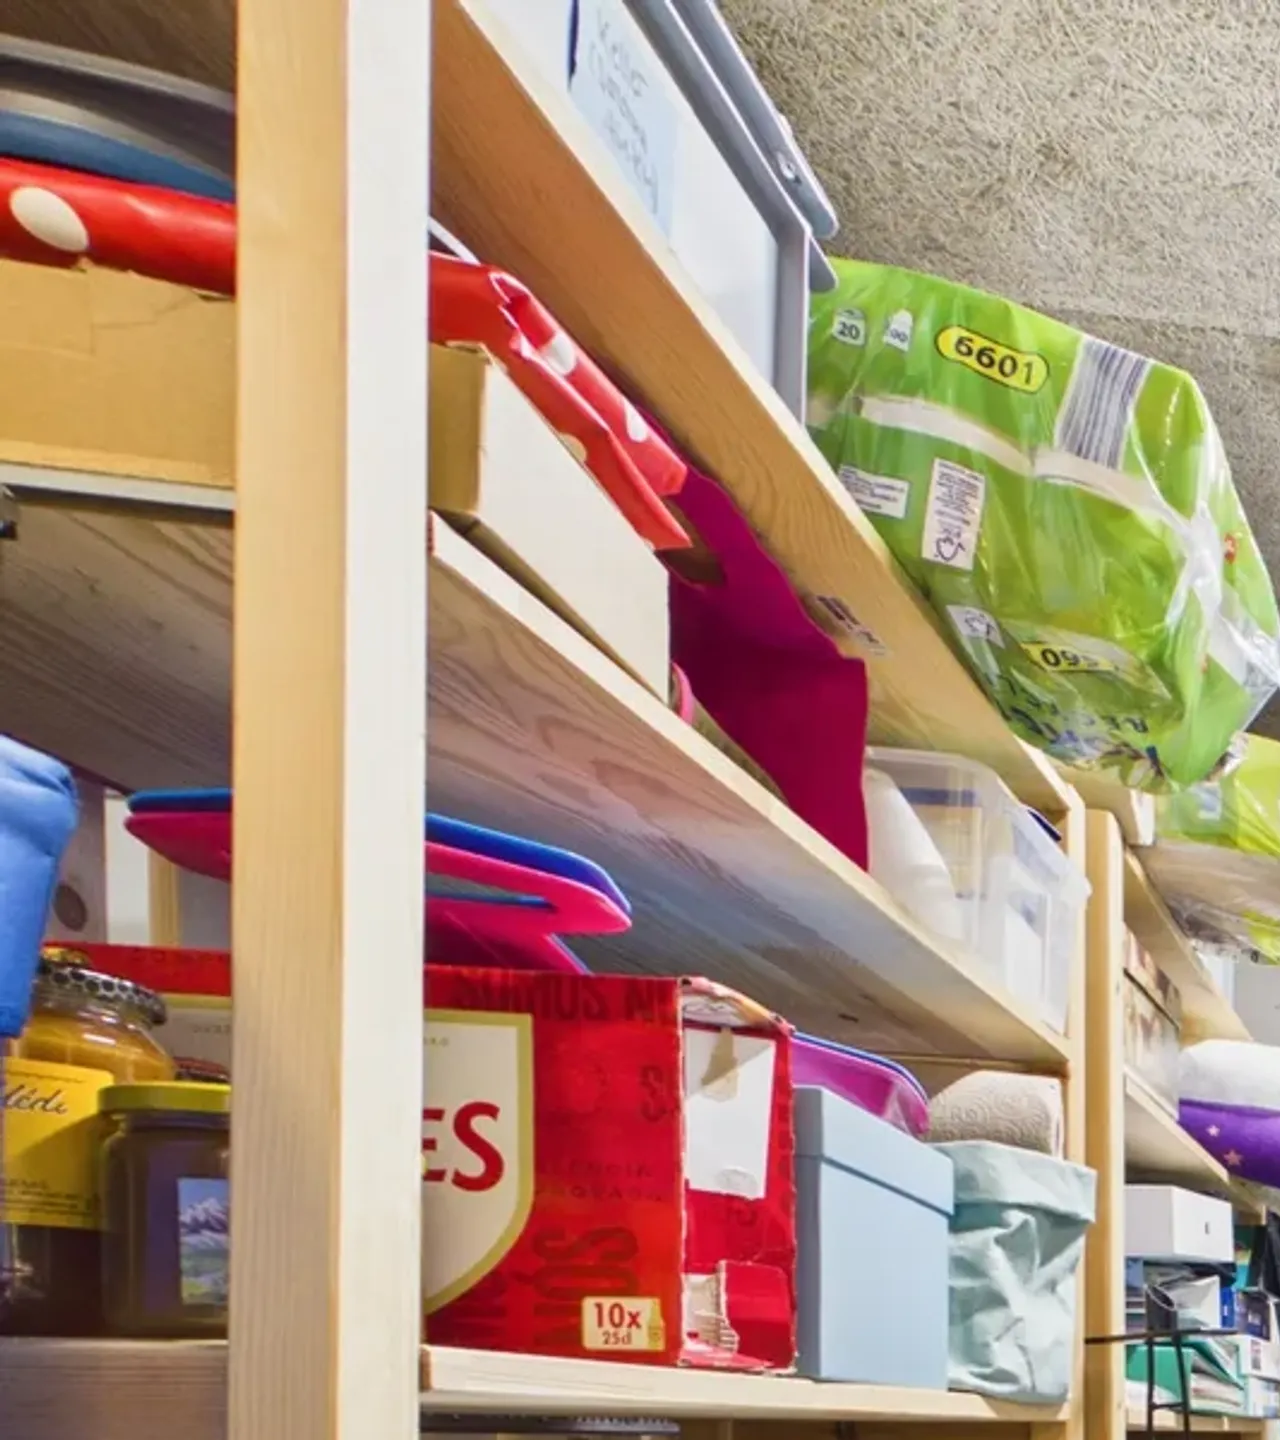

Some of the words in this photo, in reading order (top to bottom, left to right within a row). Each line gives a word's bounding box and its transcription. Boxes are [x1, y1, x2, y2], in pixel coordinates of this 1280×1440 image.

[954, 336, 1036, 386] 6601
[422, 1101, 505, 1192] ES
[594, 1302, 641, 1330] 10x
